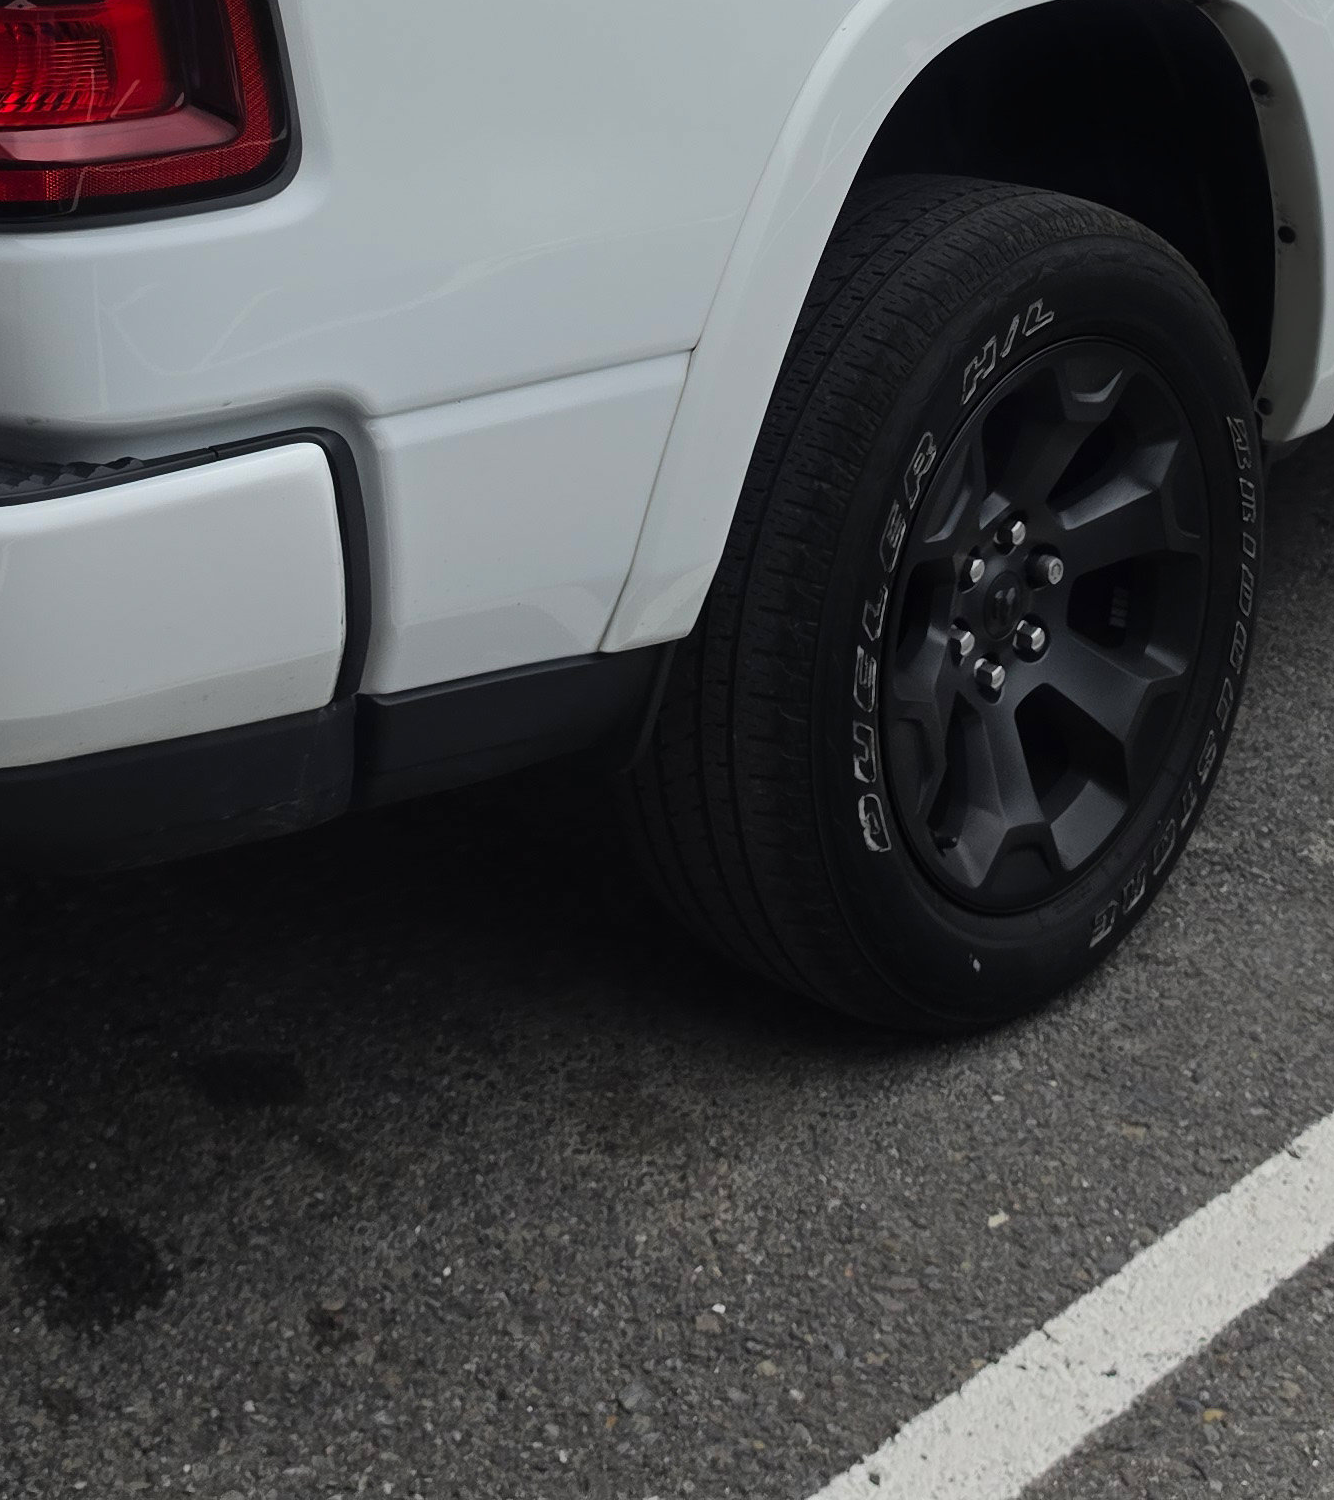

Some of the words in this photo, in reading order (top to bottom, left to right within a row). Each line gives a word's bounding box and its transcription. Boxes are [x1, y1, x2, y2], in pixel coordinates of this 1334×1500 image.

[851, 430, 936, 854] DUELER
[960, 299, 1056, 405] H/L
[1088, 415, 1258, 949] BRIDGESTONE
